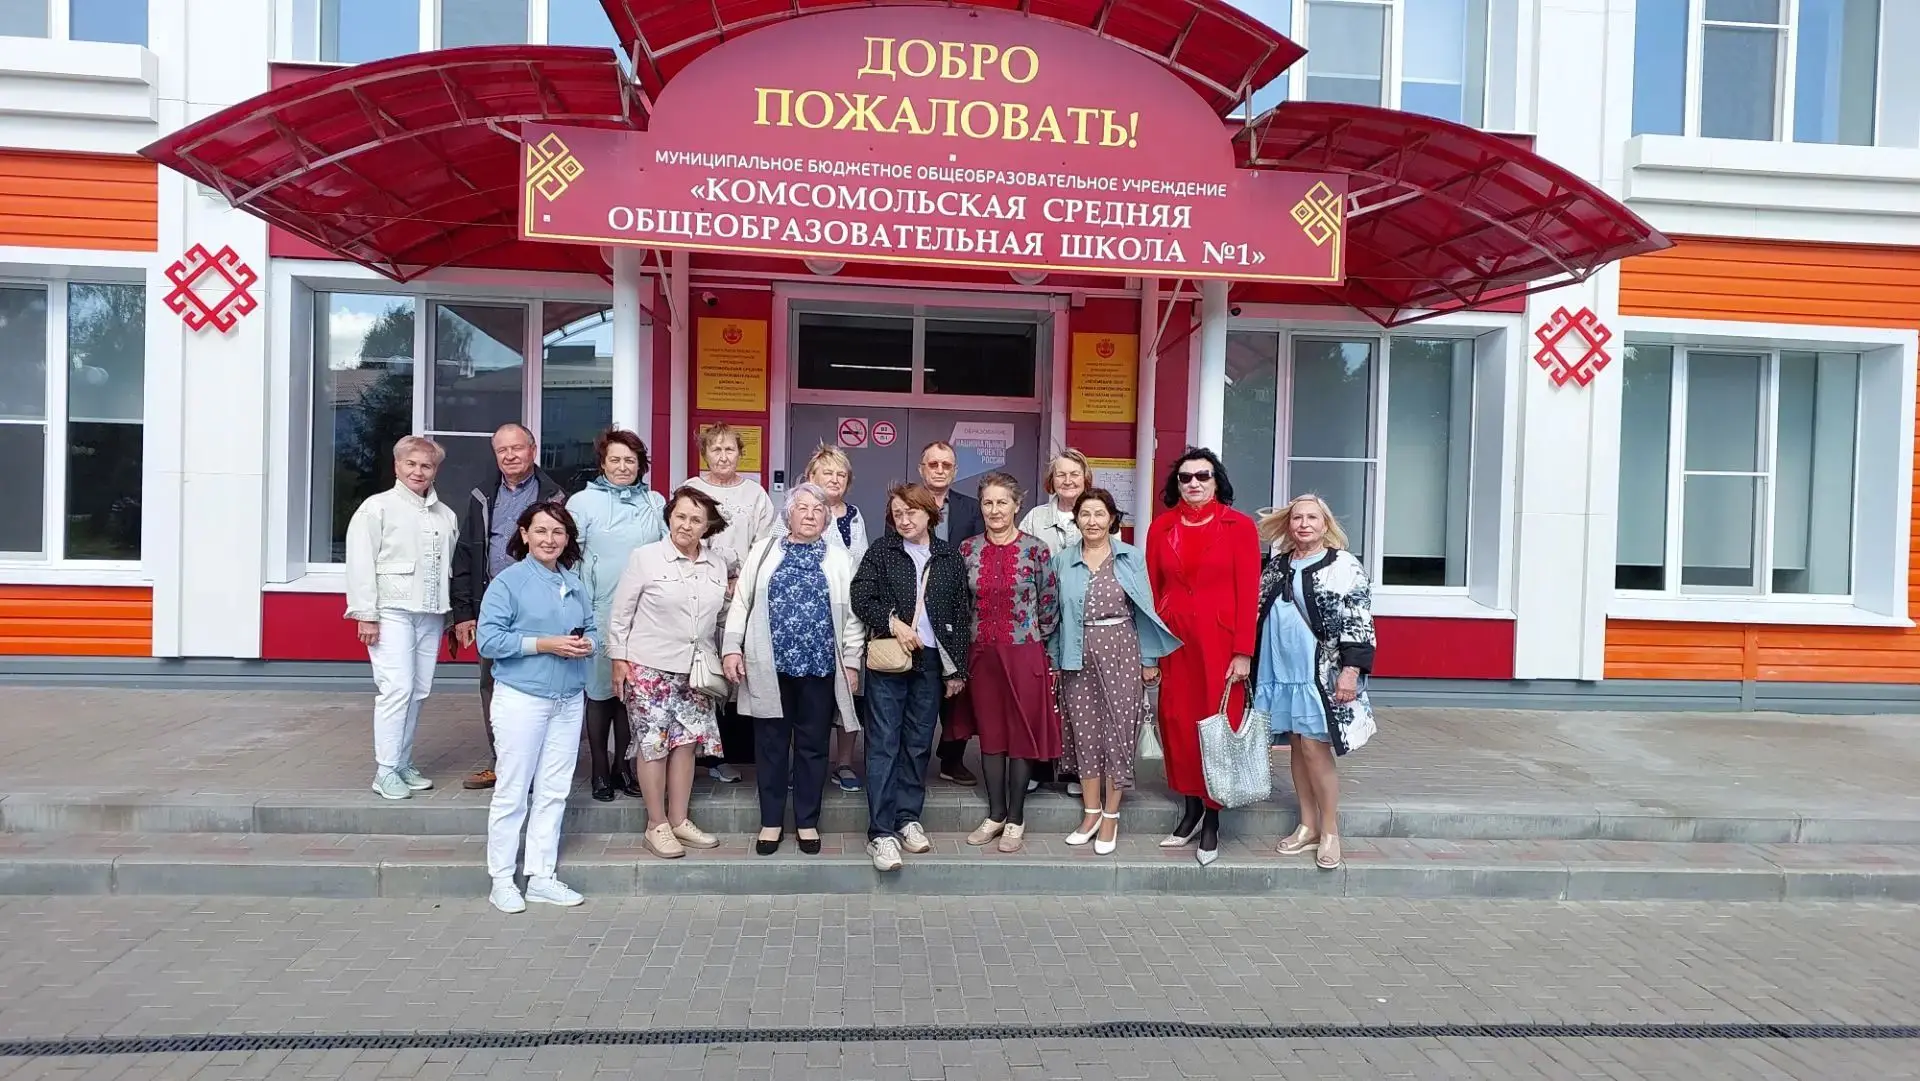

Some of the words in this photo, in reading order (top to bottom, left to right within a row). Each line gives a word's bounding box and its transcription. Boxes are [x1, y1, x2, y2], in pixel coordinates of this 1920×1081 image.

[857, 36, 1039, 84] ДОБРО
[753, 87, 1140, 149] ПОЖАЛОВАТЬ!
[655, 150, 803, 172] МУНИЦИПАЛЬНОЕ
[808, 160, 912, 179] БЮДЖЕТНОЕ
[917, 166, 1118, 191] ОБЩЕОБРАЗОВАТЕЛЬНОЕ
[1122, 178, 1227, 198] УЧРЕЖДЕНИЕ
[690, 177, 1027, 221] «КОМСОМОЛЬСКАЯ
[1043, 198, 1192, 229] СРЕДНЯЯ
[607, 206, 1044, 257] ОБЩЕОБРАЗОВАТЕЛЬНАЯ
[1060, 234, 1186, 263] ШКОЛА
[1201, 241, 1266, 266] №1»
